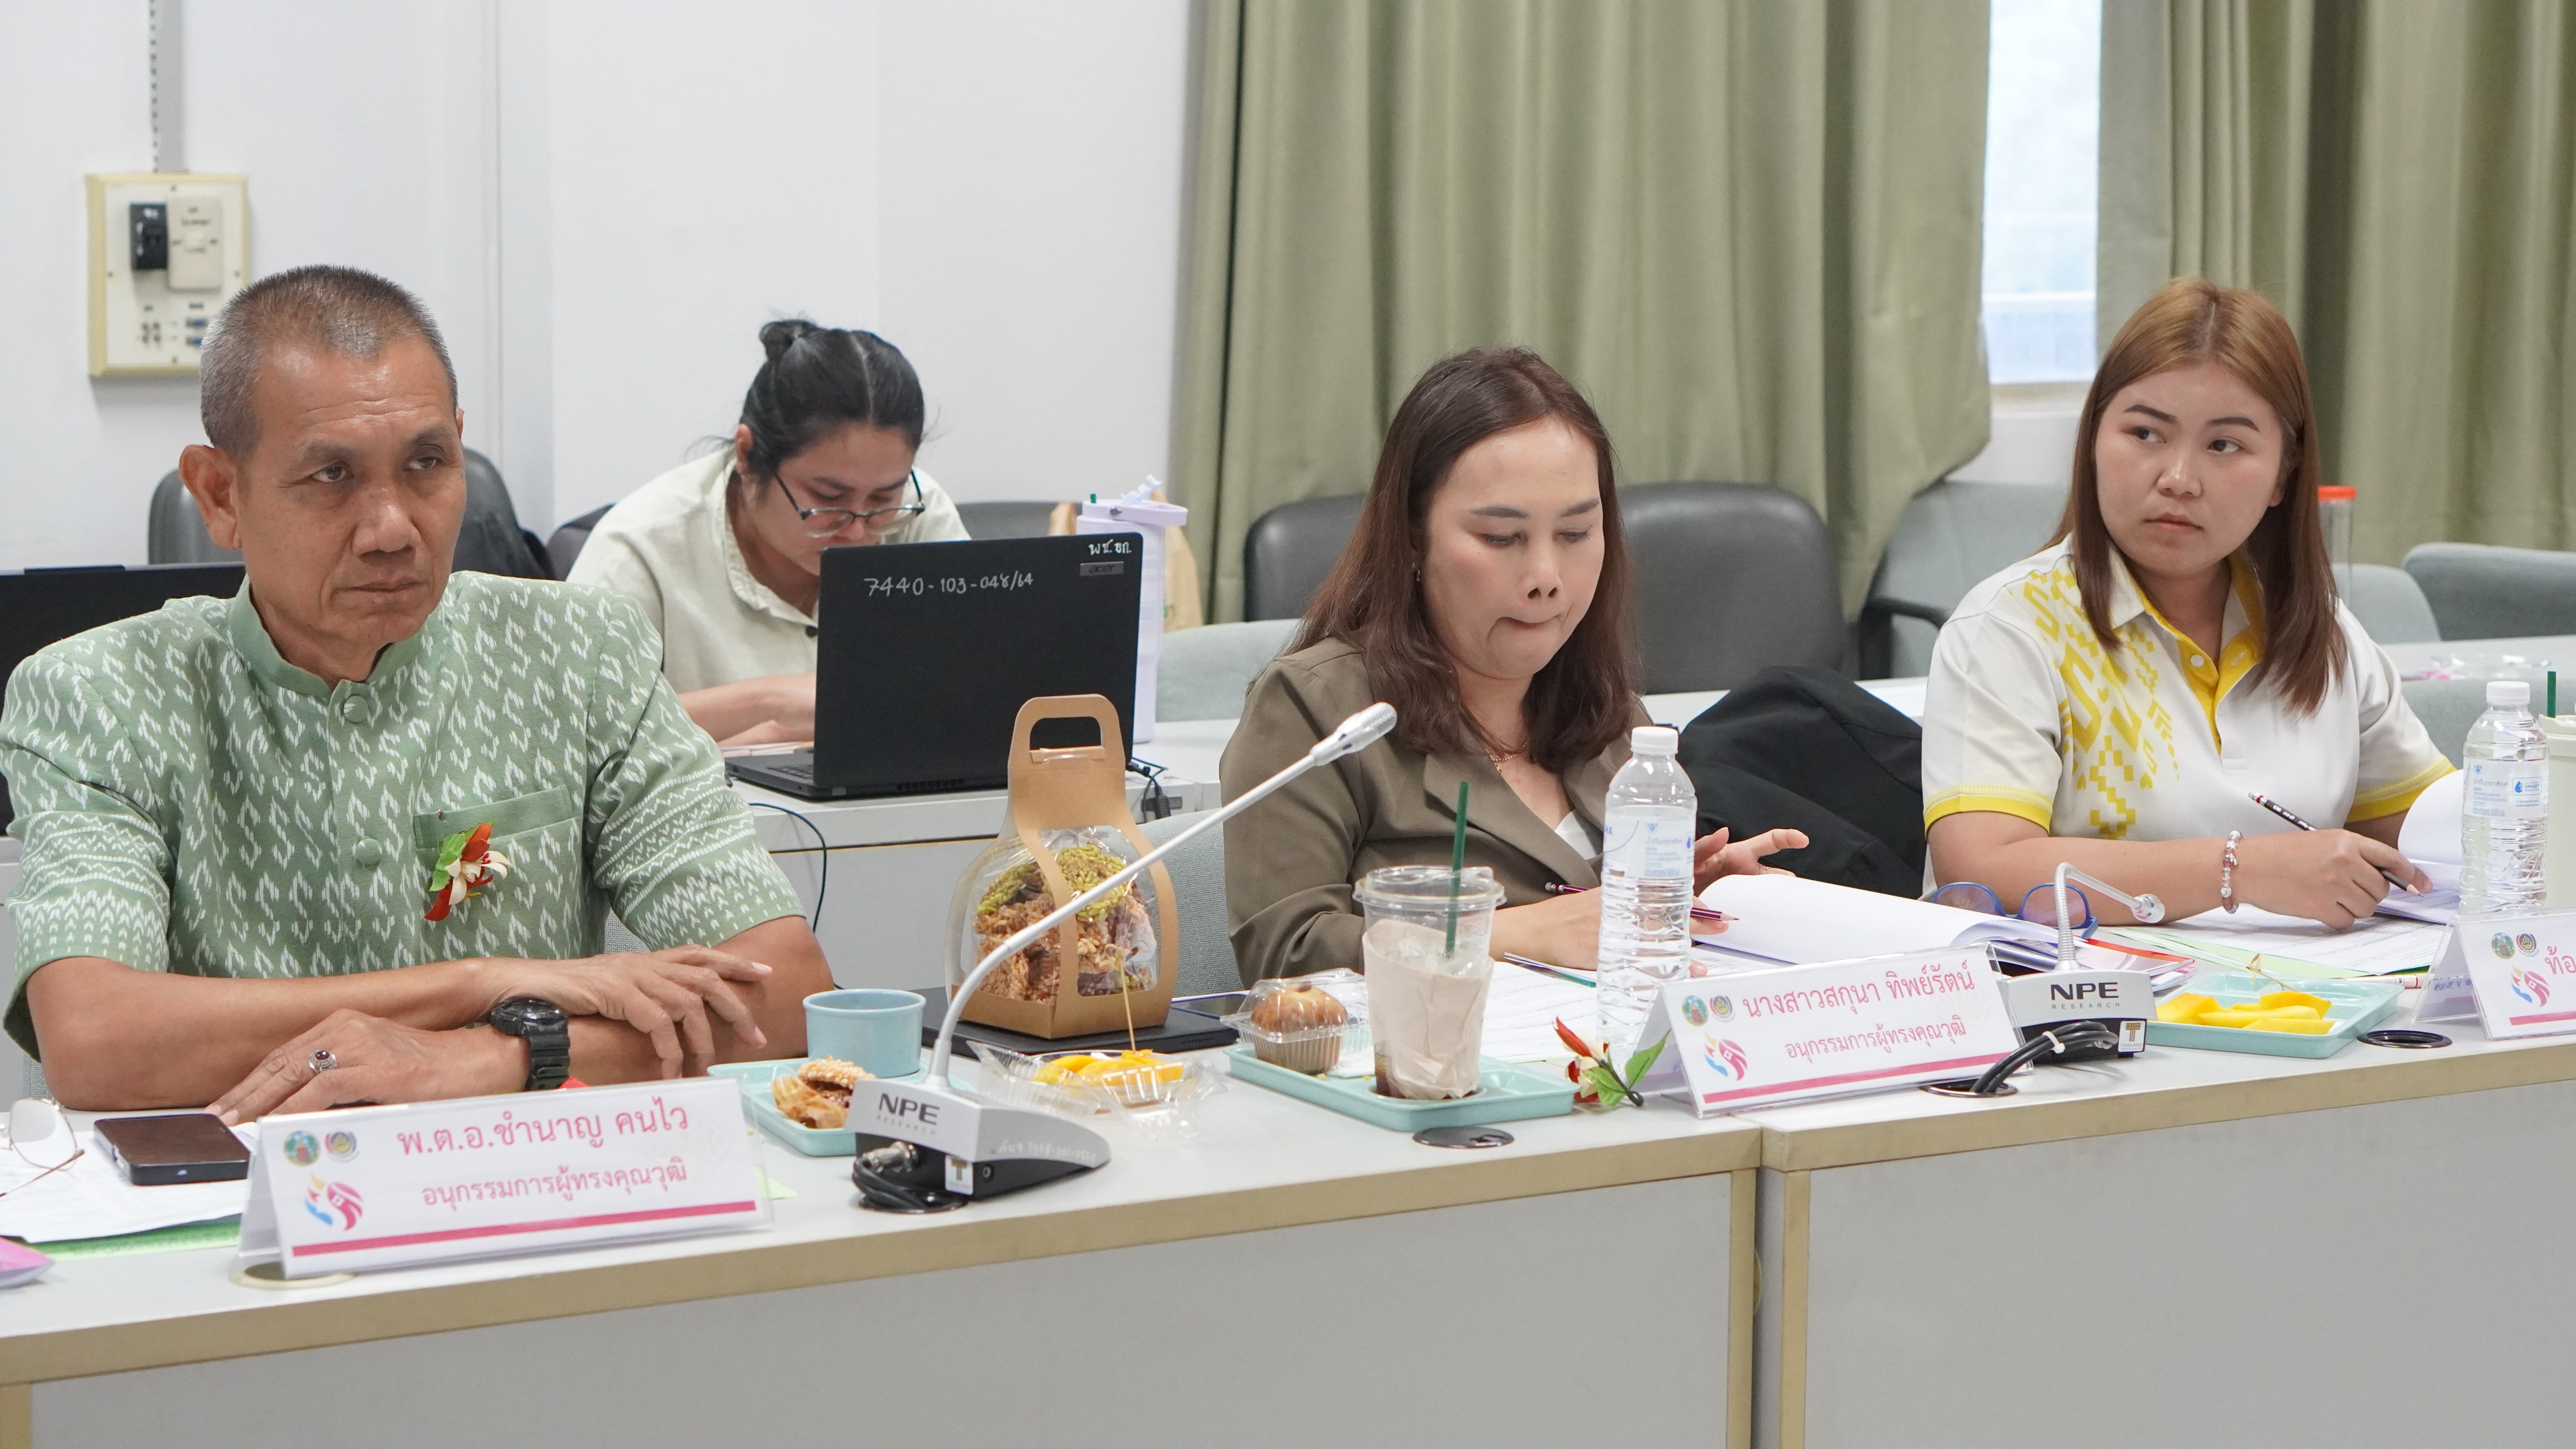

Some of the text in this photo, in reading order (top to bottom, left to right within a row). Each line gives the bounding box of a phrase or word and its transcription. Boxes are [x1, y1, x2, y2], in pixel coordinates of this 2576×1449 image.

[1089, 564, 1115, 573] acer
[2491, 808, 2499, 816] 600
[1742, 960, 1975, 1017] นางสาวสกุนา ทิพย์รัตน์
[2050, 982, 2119, 1000] NPE
[2052, 1002, 2120, 1010] RESEARCH
[1785, 1015, 1967, 1064] อนุกรรมการผู้ทรงคุณวุฒิ
[879, 1093, 940, 1125] NPE
[397, 1097, 688, 1155] พ.ต.อ.ชำนาญ คนไว
[422, 1156, 687, 1211] อนุกรรมการผู้ทรงคุณวุฒิ
